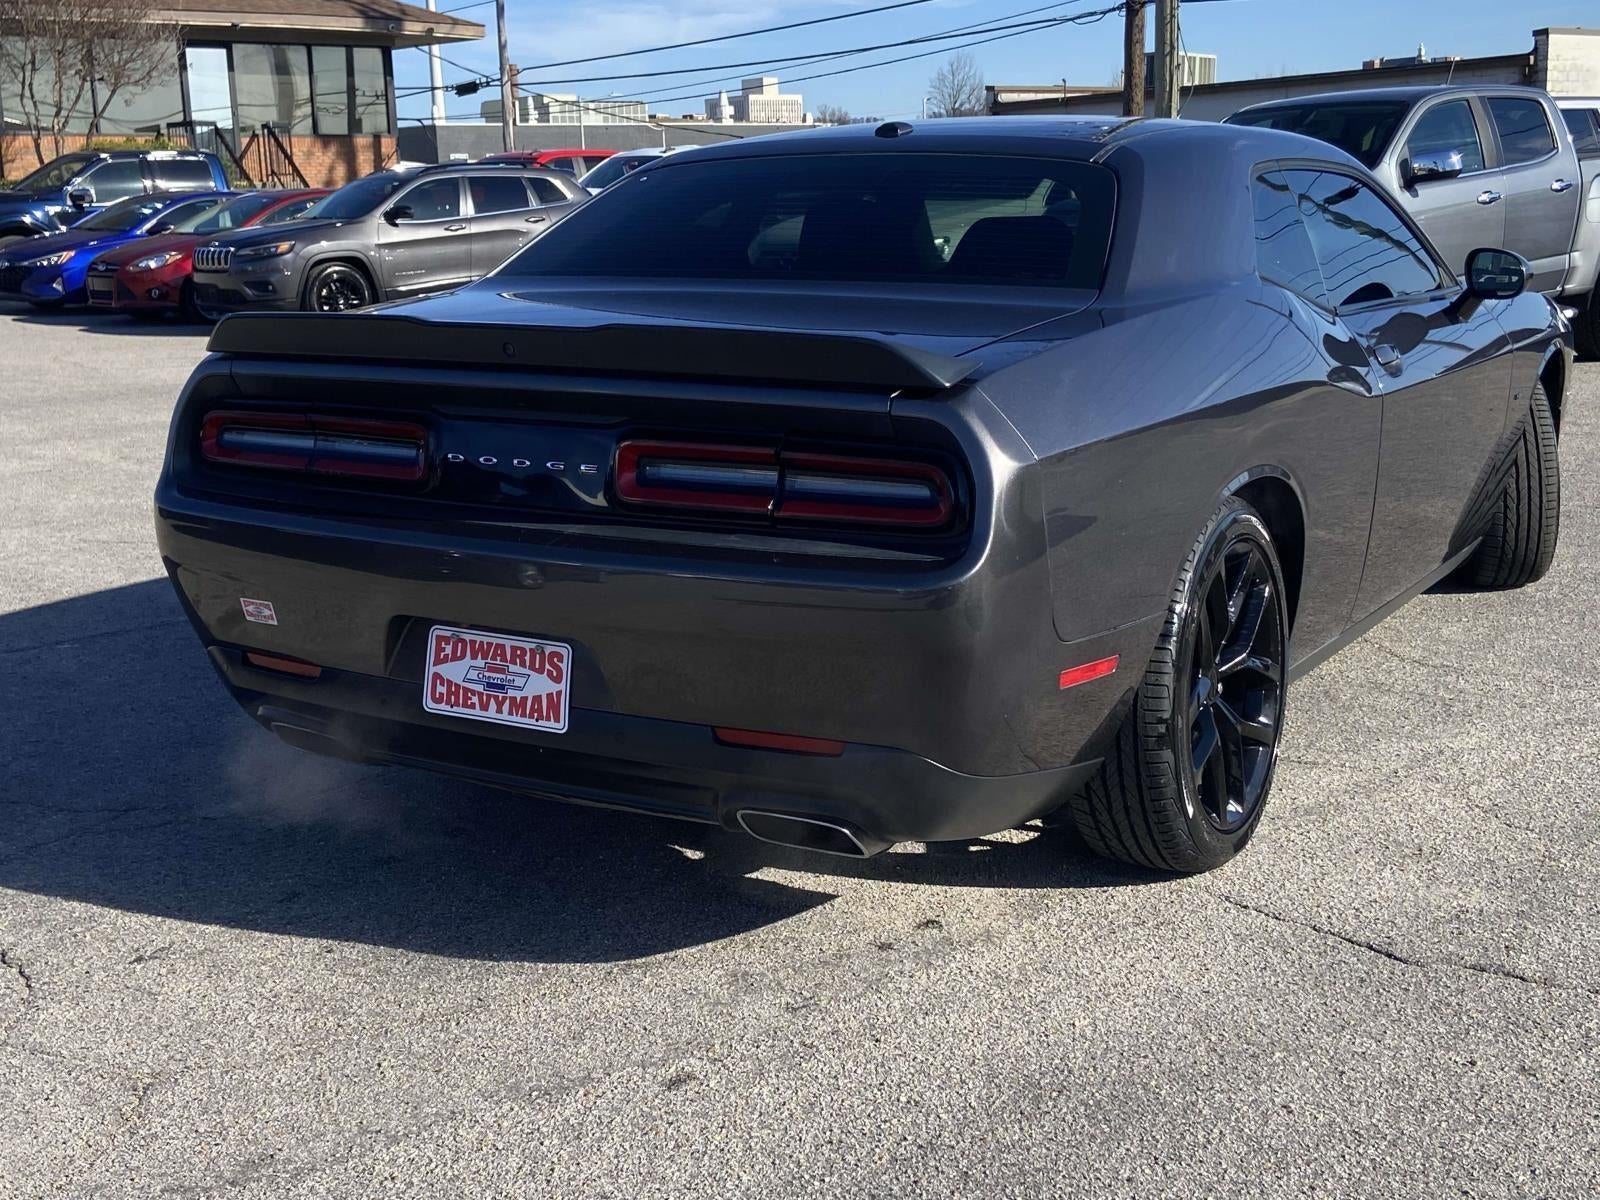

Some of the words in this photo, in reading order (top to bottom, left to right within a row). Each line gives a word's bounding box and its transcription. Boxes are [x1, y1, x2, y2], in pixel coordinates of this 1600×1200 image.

[447, 453, 598, 473] DODGE
[432, 634, 564, 685] EDWARDS
[476, 672, 516, 685] Chevrolet
[430, 671, 563, 724] CHEVYMAN
